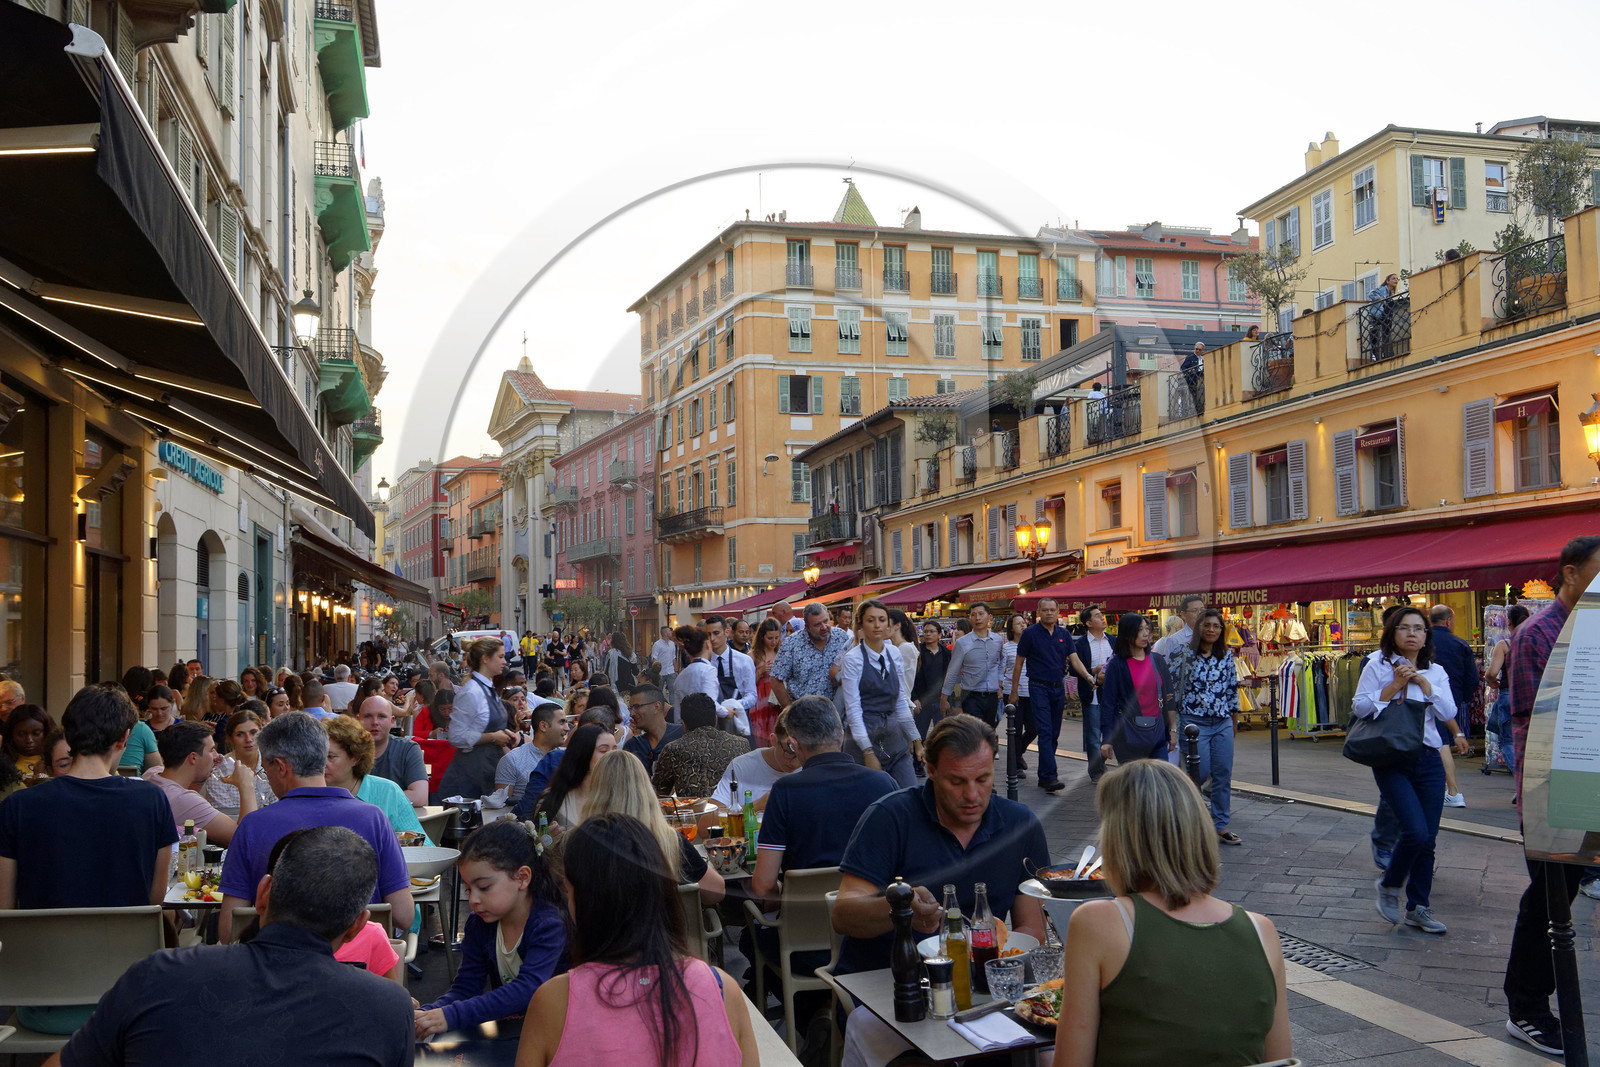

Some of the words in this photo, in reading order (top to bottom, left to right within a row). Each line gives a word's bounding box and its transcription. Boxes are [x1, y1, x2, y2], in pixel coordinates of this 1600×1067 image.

[1268, 454, 1275, 464] H
[194, 461, 225, 495] AGRICOLE
[1092, 559, 1099, 568] LE
[1099, 556, 1124, 567] HUSSARD
[1354, 582, 1400, 596] Produits
[1403, 578, 1470, 594] Régionaux
[1149, 595, 1161, 608] AU
[1163, 593, 1199, 607] MARC
[1201, 592, 1213, 605] DE
[1215, 589, 1268, 604] PROVENCE
